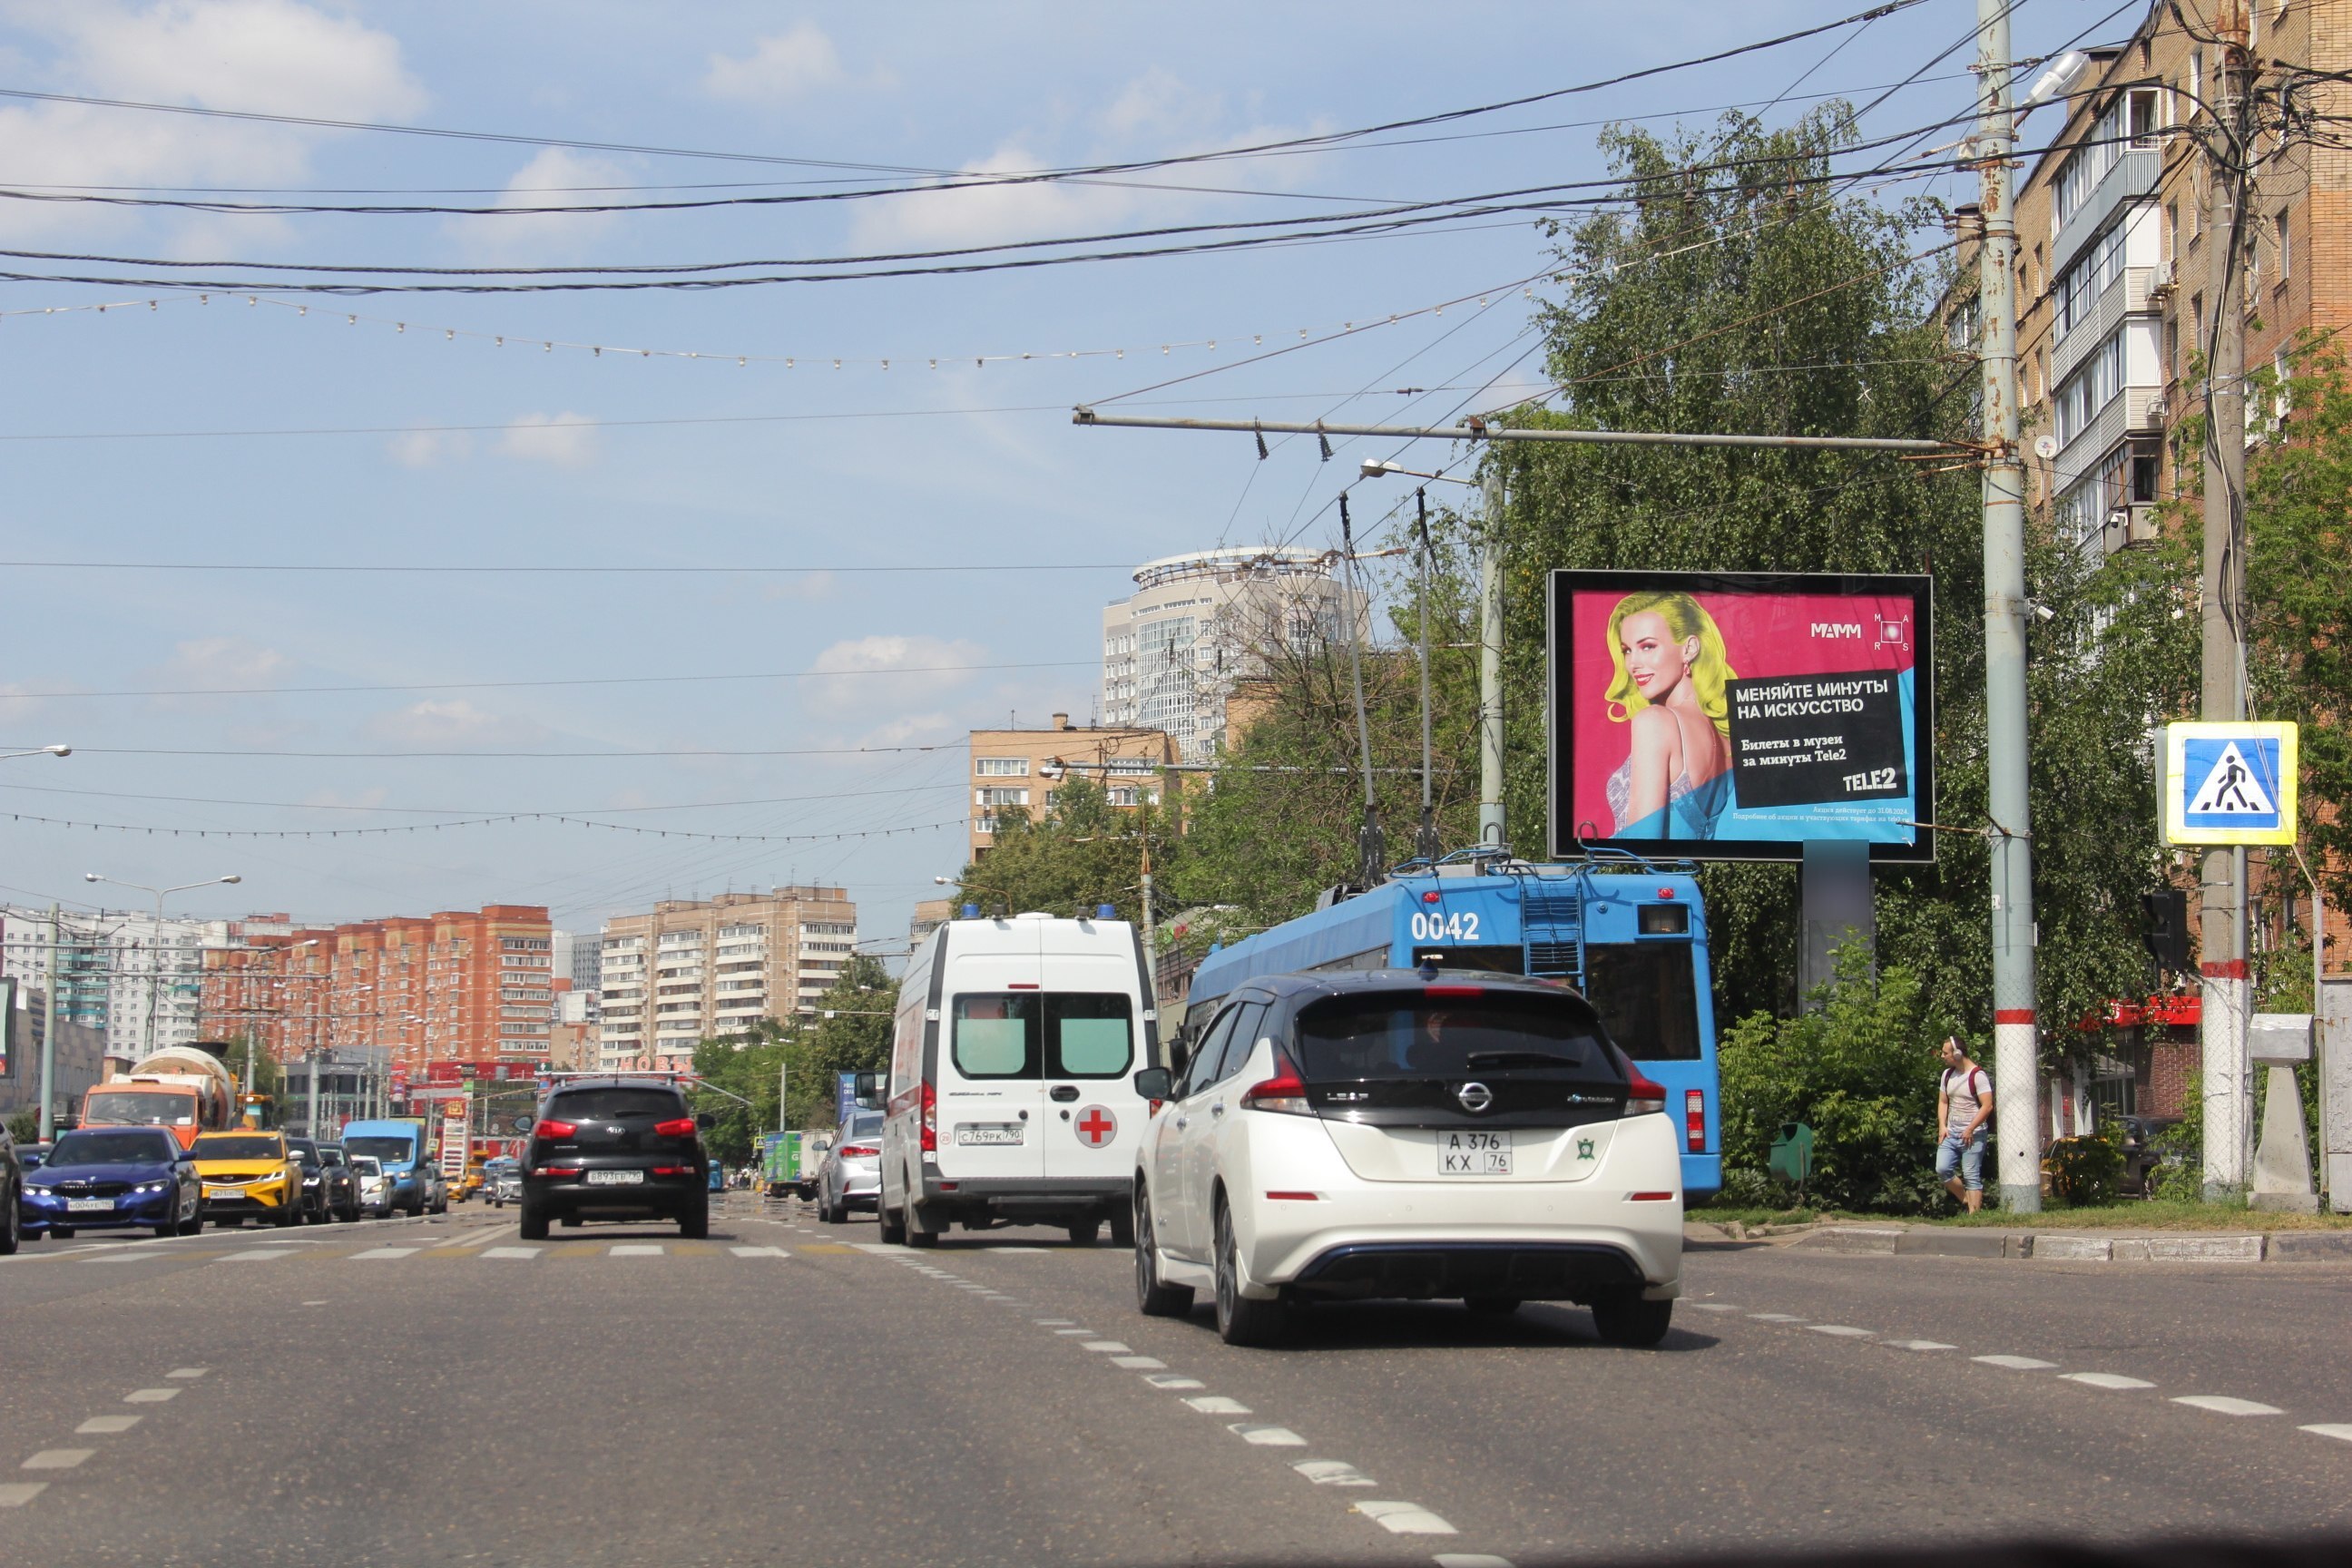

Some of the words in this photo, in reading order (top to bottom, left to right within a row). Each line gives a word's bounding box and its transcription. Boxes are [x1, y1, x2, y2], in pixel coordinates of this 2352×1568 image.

[1736, 682, 1813, 702] МЕНЯЙТЕ
[1817, 680, 1888, 697] МИНУТЫ
[1737, 705, 1761, 720] НА
[1765, 698, 1864, 718] ИСКУССТВО
[1741, 740, 1789, 751] Билеты
[1793, 739, 1800, 748] в
[1803, 735, 1843, 750] музеи
[1742, 758, 1756, 767] за
[1759, 753, 1811, 768] минуты
[1814, 749, 1847, 762] Tele2
[1843, 767, 1897, 791] TELE2
[1835, 807, 1866, 815] действует
[1411, 912, 1479, 940] 0042
[1004, 1130, 1020, 1139] 790
[1467, 1133, 1500, 1150] 376
[1490, 1154, 1506, 1167] 76
